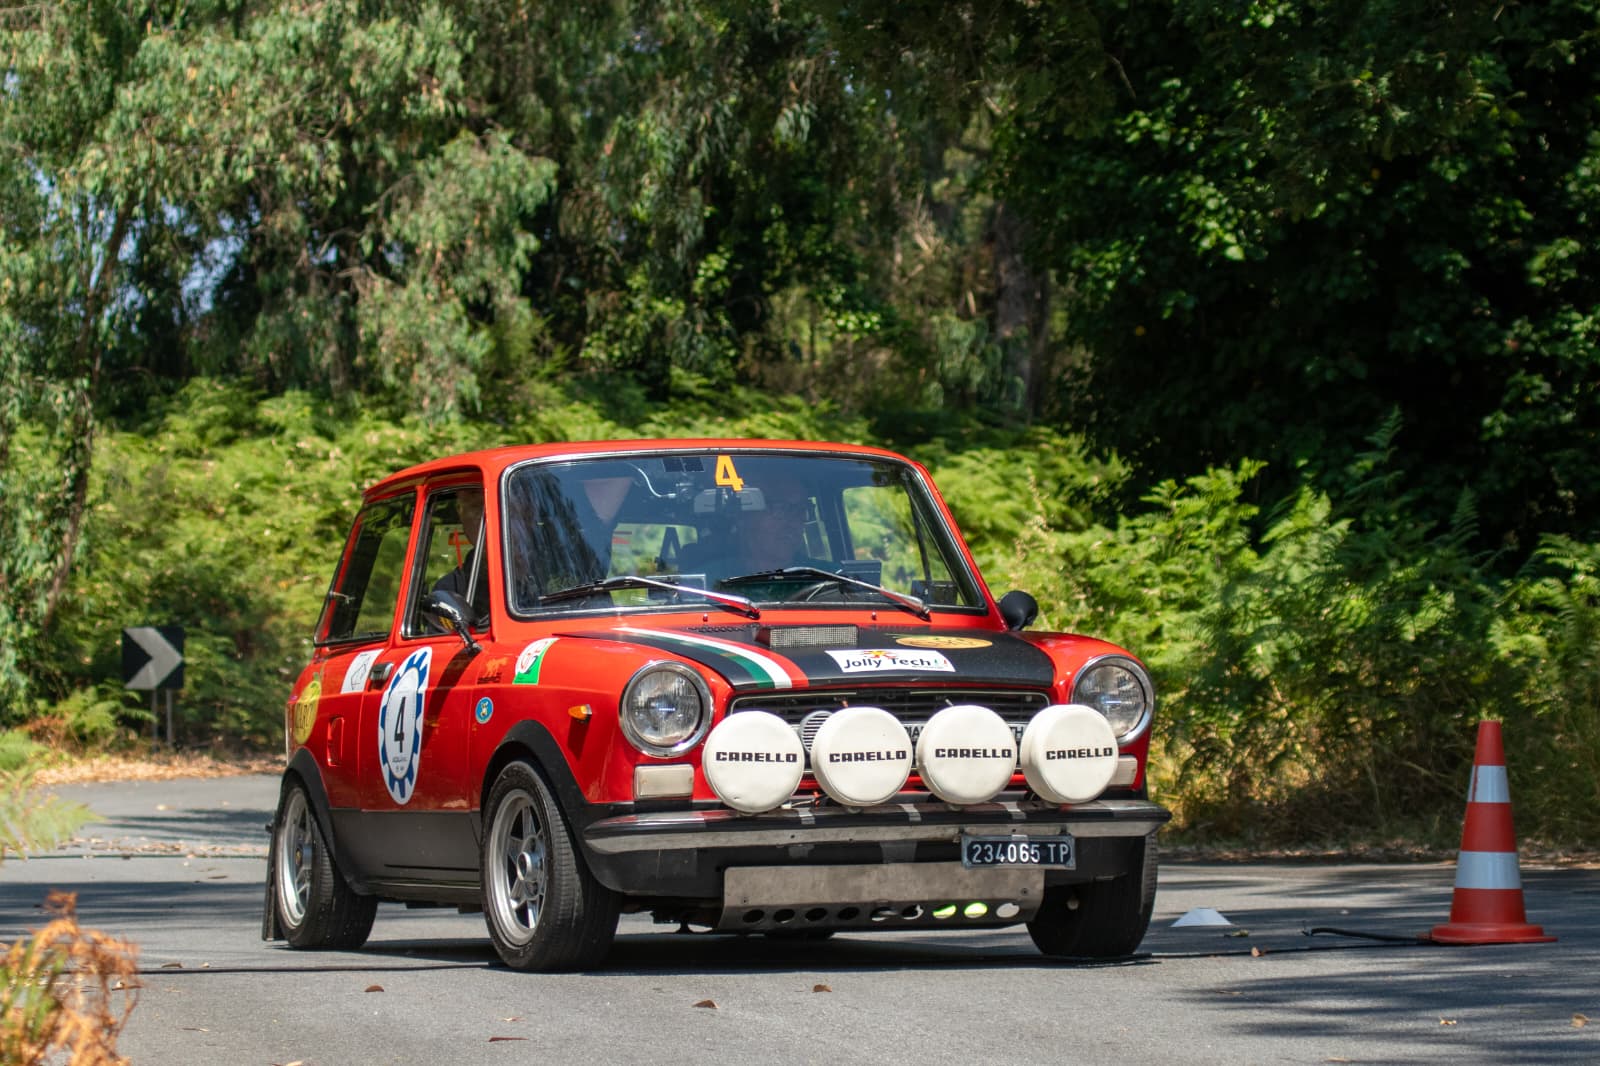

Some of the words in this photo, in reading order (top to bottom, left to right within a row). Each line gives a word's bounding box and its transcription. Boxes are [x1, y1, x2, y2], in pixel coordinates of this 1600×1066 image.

[715, 454, 744, 492] 4
[844, 658, 882, 669] Jolly
[891, 658, 932, 667] Tech
[394, 696, 406, 753] 4
[715, 751, 798, 763] CARELLO
[829, 750, 907, 763] CARELLO
[935, 748, 1012, 759] CARELLO
[1046, 747, 1113, 761] CARELLO
[972, 843, 1041, 863] 234065
[1047, 843, 1070, 863] TP
